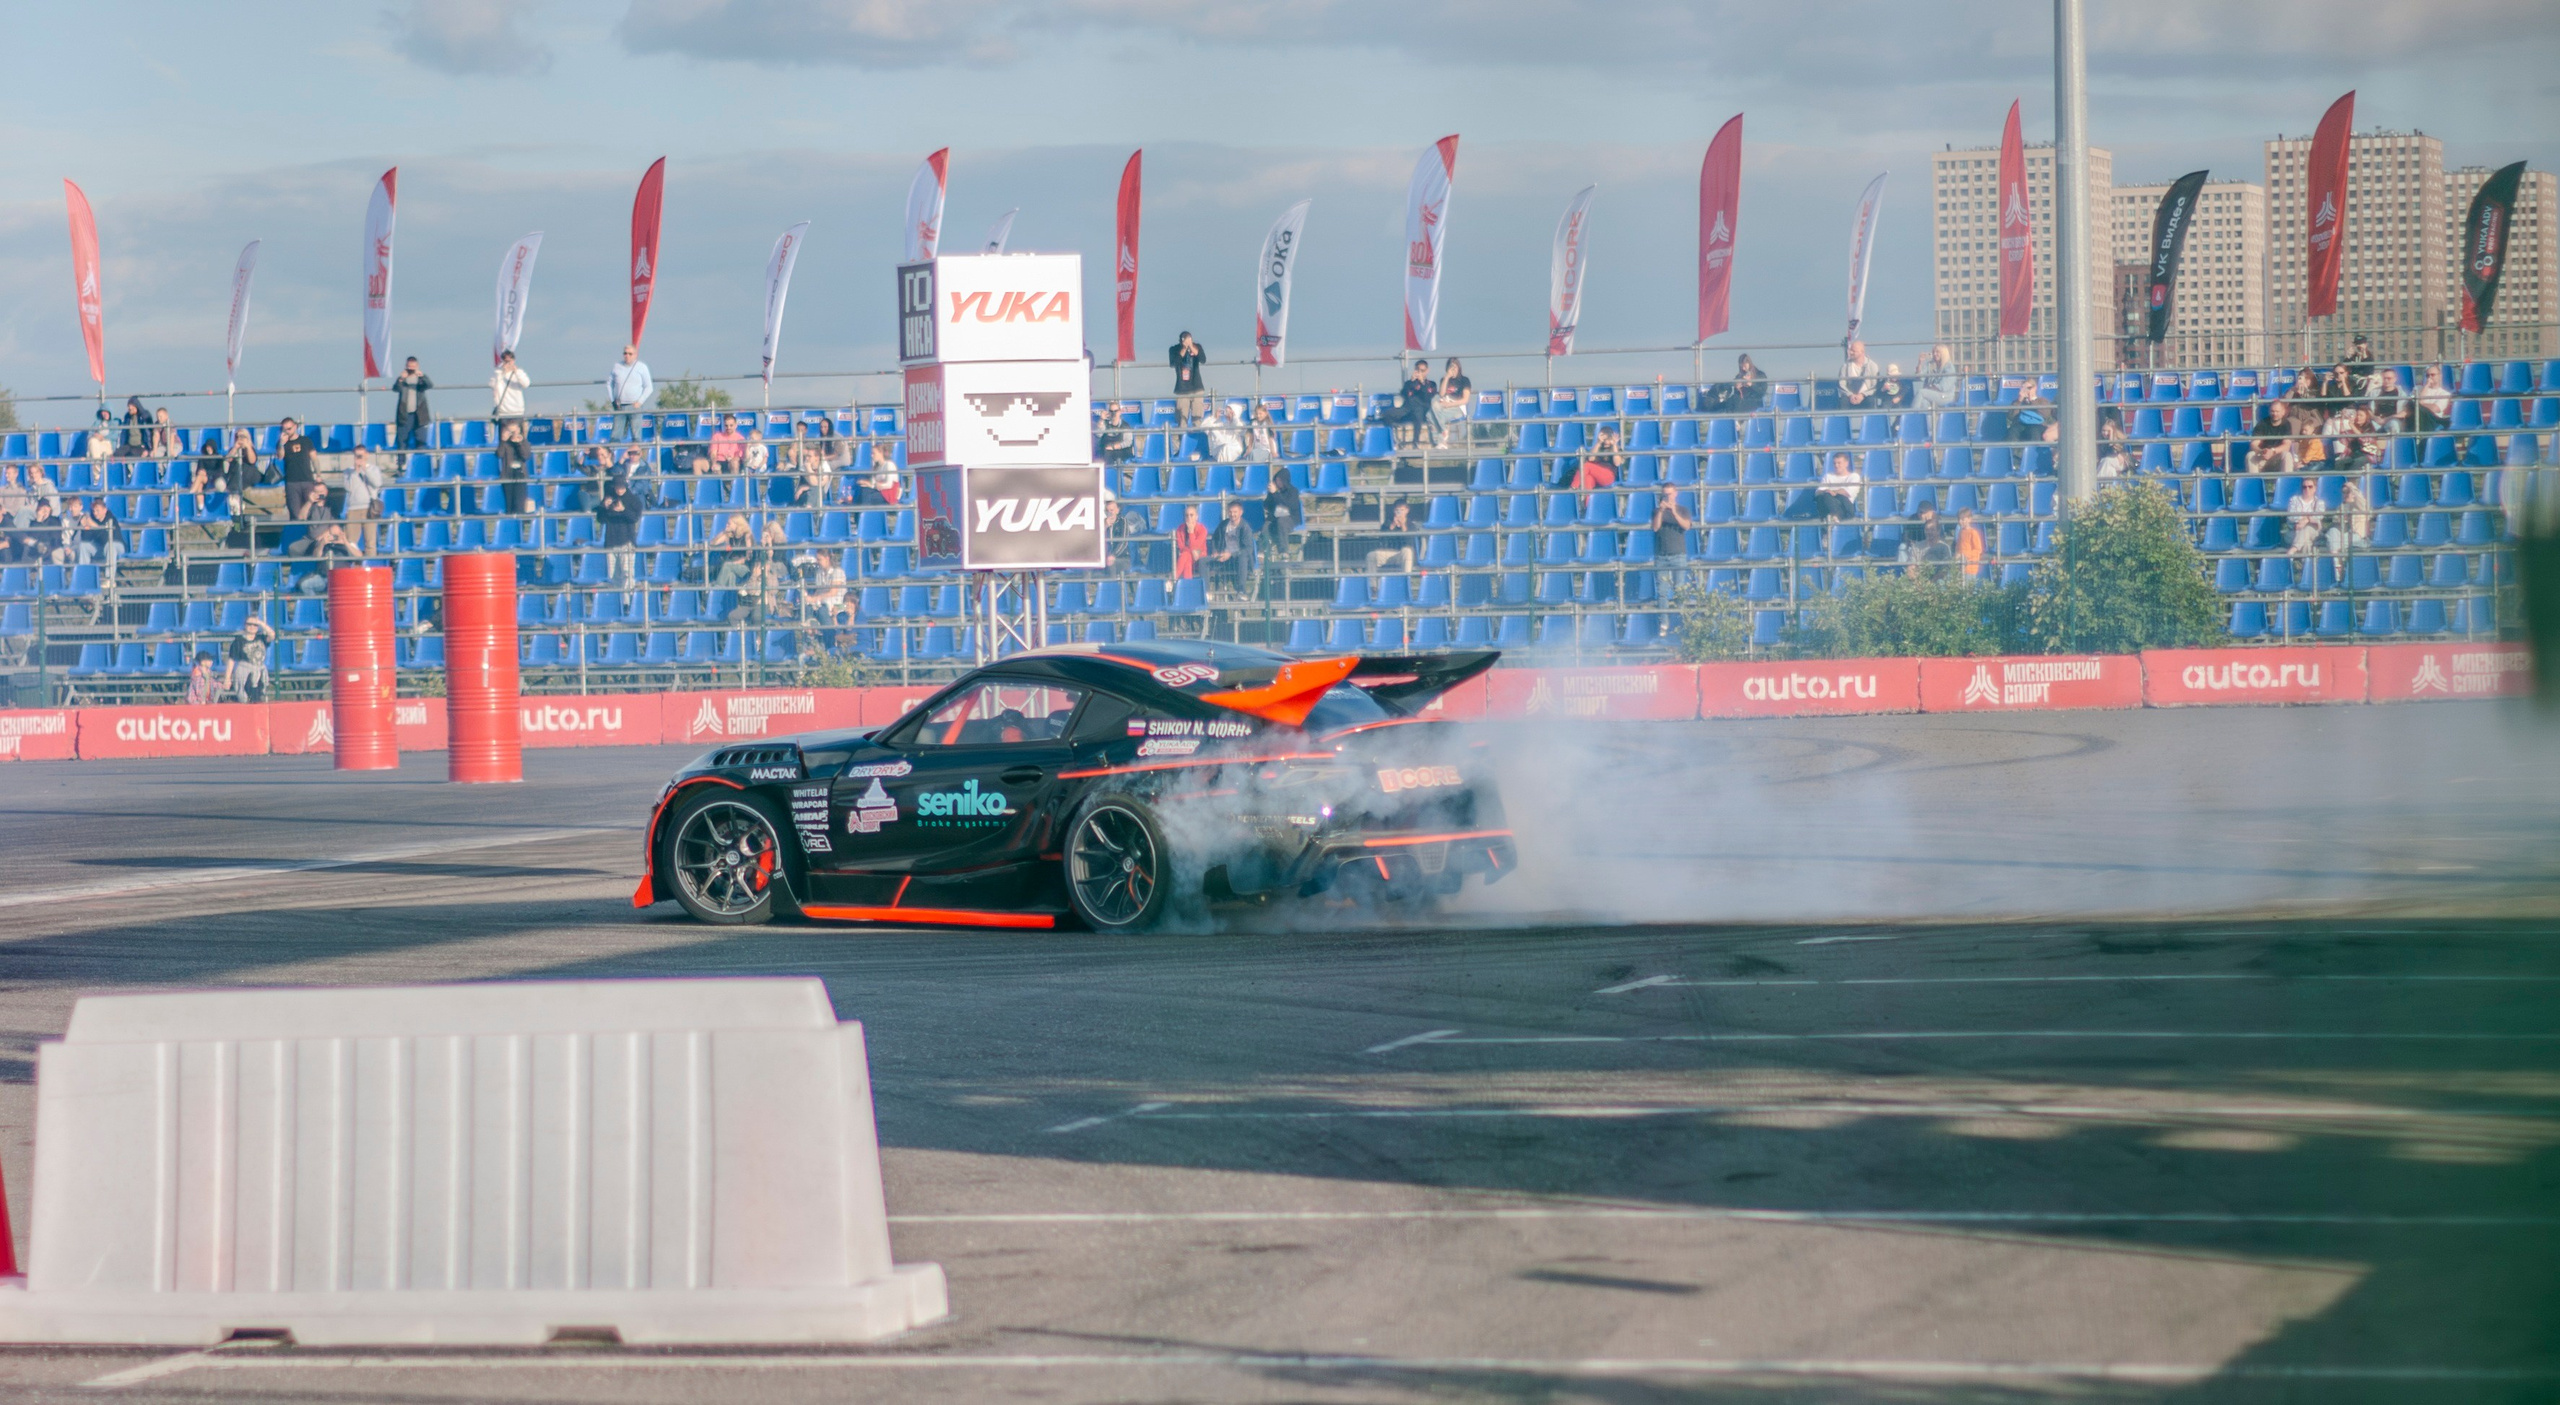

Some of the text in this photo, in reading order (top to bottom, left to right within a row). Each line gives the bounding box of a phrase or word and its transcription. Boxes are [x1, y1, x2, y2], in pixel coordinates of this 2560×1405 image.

[2161, 196, 2187, 249] Видео
[2477, 228, 2489, 254] YUKA
[905, 271, 933, 313] ГО
[950, 291, 1070, 323] YUKA
[975, 497, 1096, 533] YUKA
[2004, 656, 2101, 684] МОСКОВСКИЙ
[2182, 661, 2320, 690] auto.ru
[1743, 672, 1877, 701] auto.ru
[2004, 682, 2051, 704] СПОРТ
[521, 704, 623, 732] uto.ru
[728, 692, 815, 716] МОСКОВСКИЙ
[0, 712, 66, 736] СКОВСКИЙ
[116, 713, 232, 742] auto.ru
[728, 714, 769, 736] СПОРТ
[1148, 720, 1191, 736] SHIKOV
[1193, 721, 1205, 736] N.
[792, 800, 828, 810] WRAPCAR
[793, 788, 828, 798] WHITELAB
[917, 778, 1007, 816] seniko
[957, 820, 1007, 829] systems
